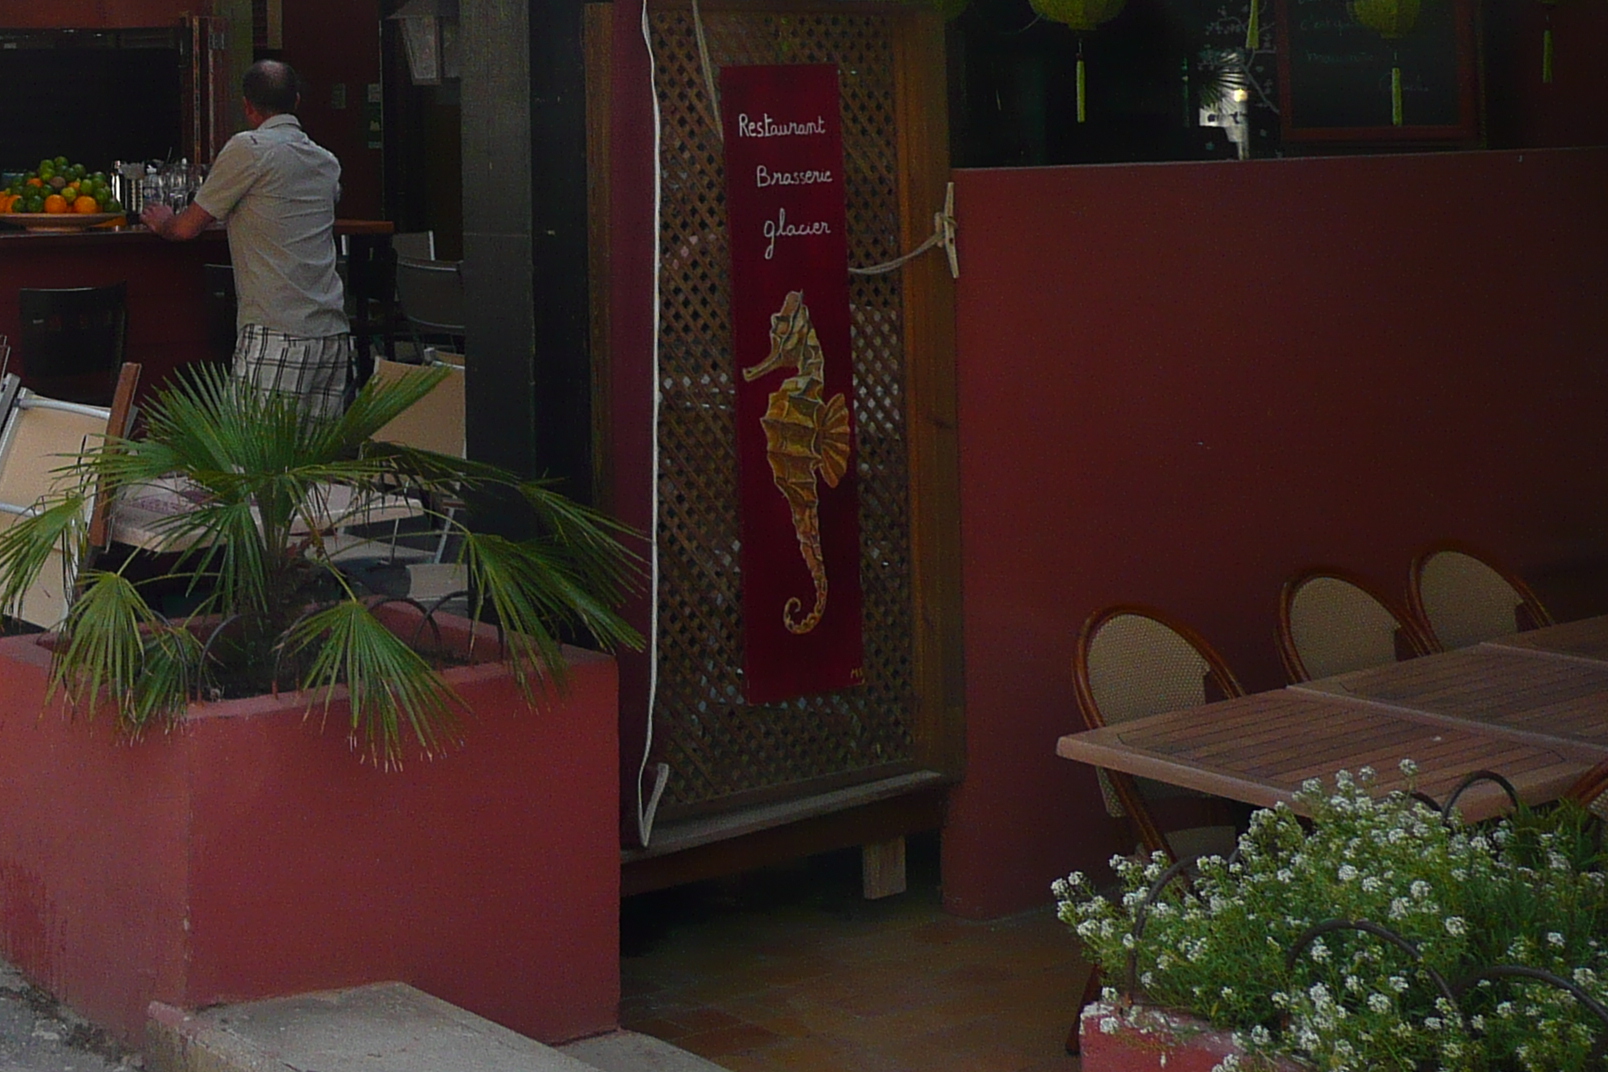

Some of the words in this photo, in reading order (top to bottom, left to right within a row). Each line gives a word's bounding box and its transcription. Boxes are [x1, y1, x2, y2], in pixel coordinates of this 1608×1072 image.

[738, 112, 826, 138] Restaurant
[756, 164, 833, 188] Brasserie
[763, 208, 831, 260] glacier
